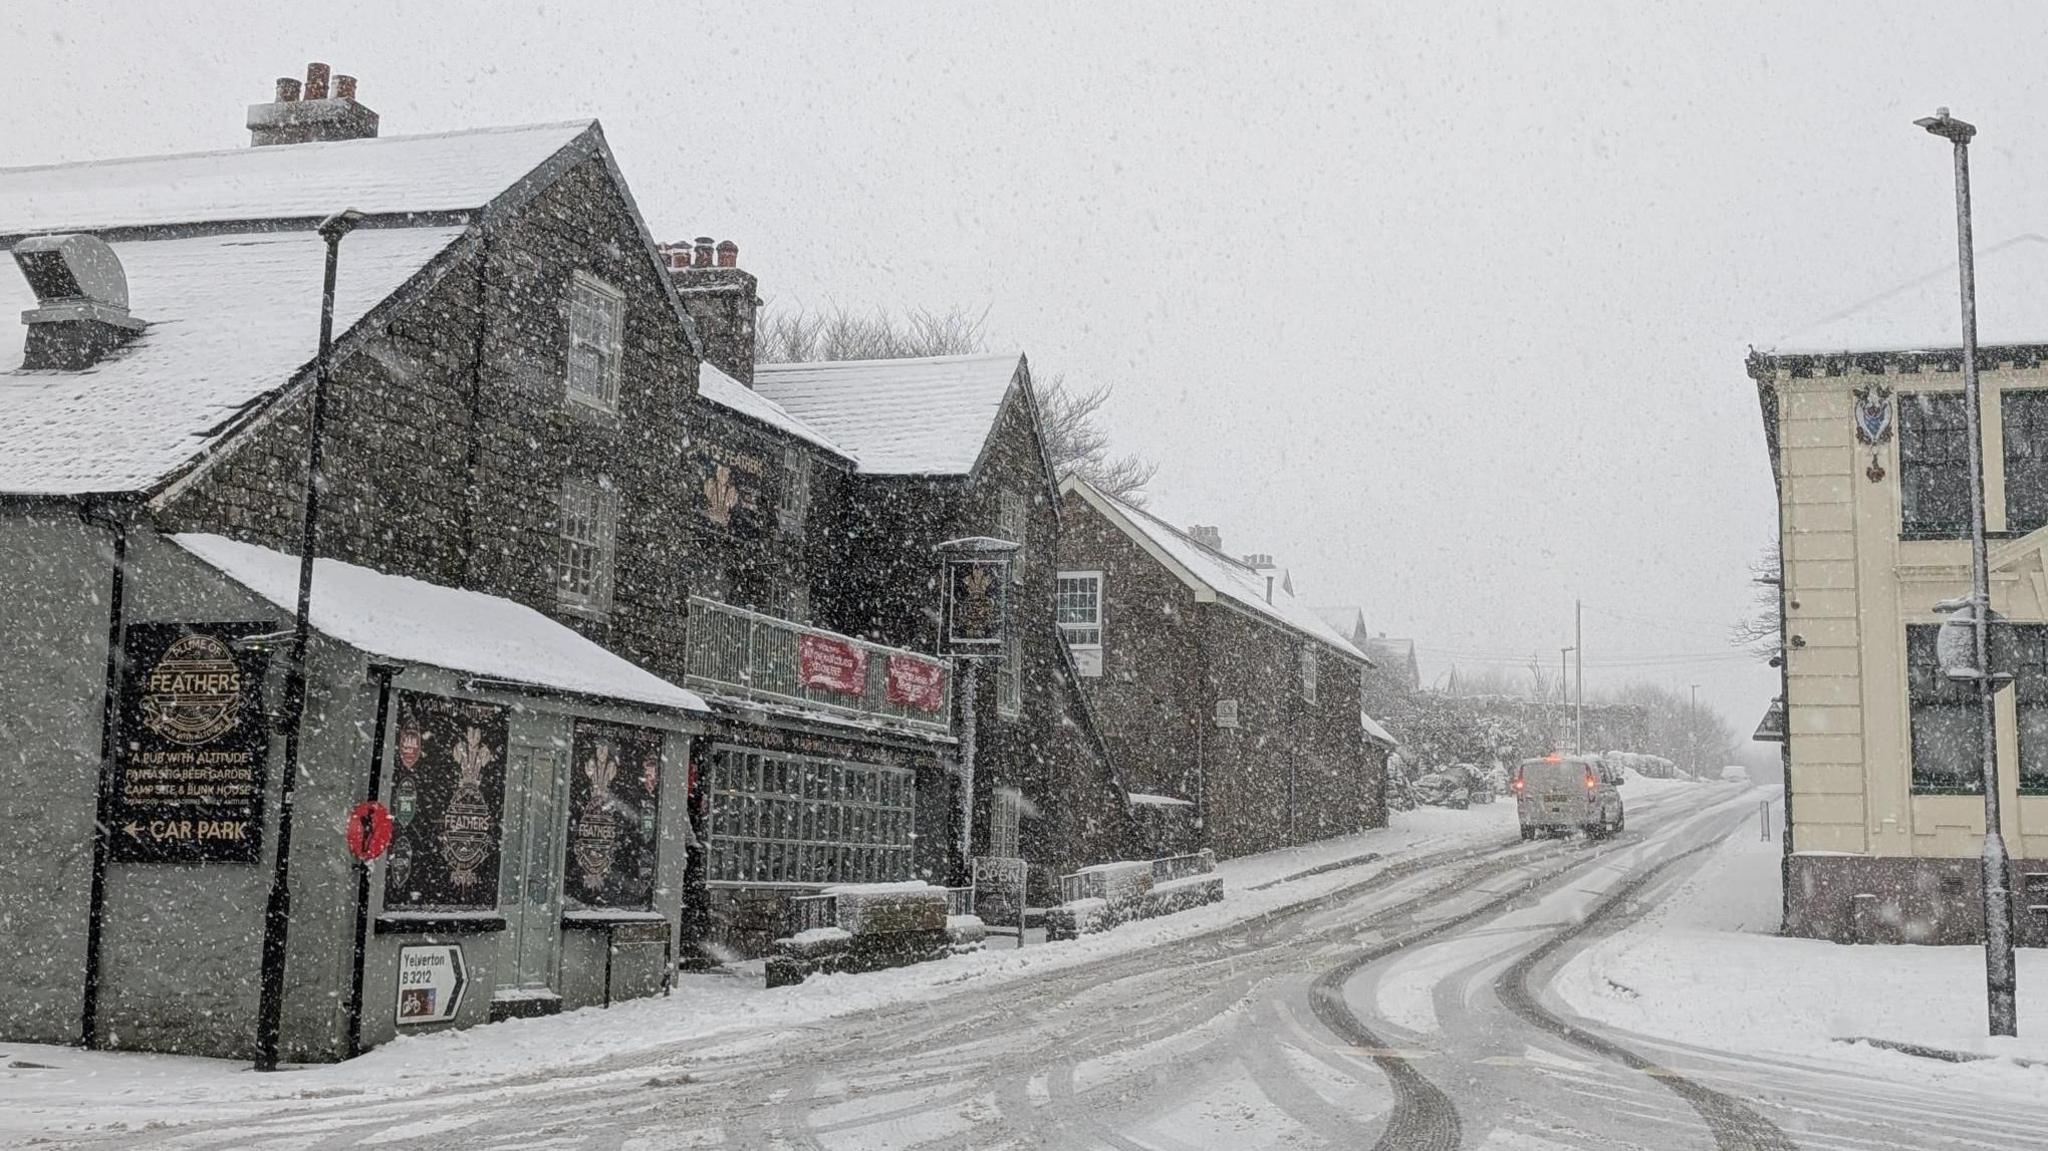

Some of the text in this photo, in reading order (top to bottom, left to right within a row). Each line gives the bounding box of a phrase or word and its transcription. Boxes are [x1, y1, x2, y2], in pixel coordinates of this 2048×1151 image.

[150, 674, 240, 692] FEATHERS
[143, 752, 164, 764] PUB
[167, 752, 195, 764] WITH
[182, 768, 206, 780] BEER
[208, 768, 252, 780] GARDEN
[124, 784, 154, 796] CAMP
[187, 784, 214, 796] BUNK
[216, 784, 251, 796] HOUSE
[150, 820, 248, 840] CAR PARK
[445, 815, 490, 830] FEATHERS
[579, 823, 616, 839] FEATHERS
[404, 953, 445, 968] Yelverton
[402, 970, 432, 985] B 3212
